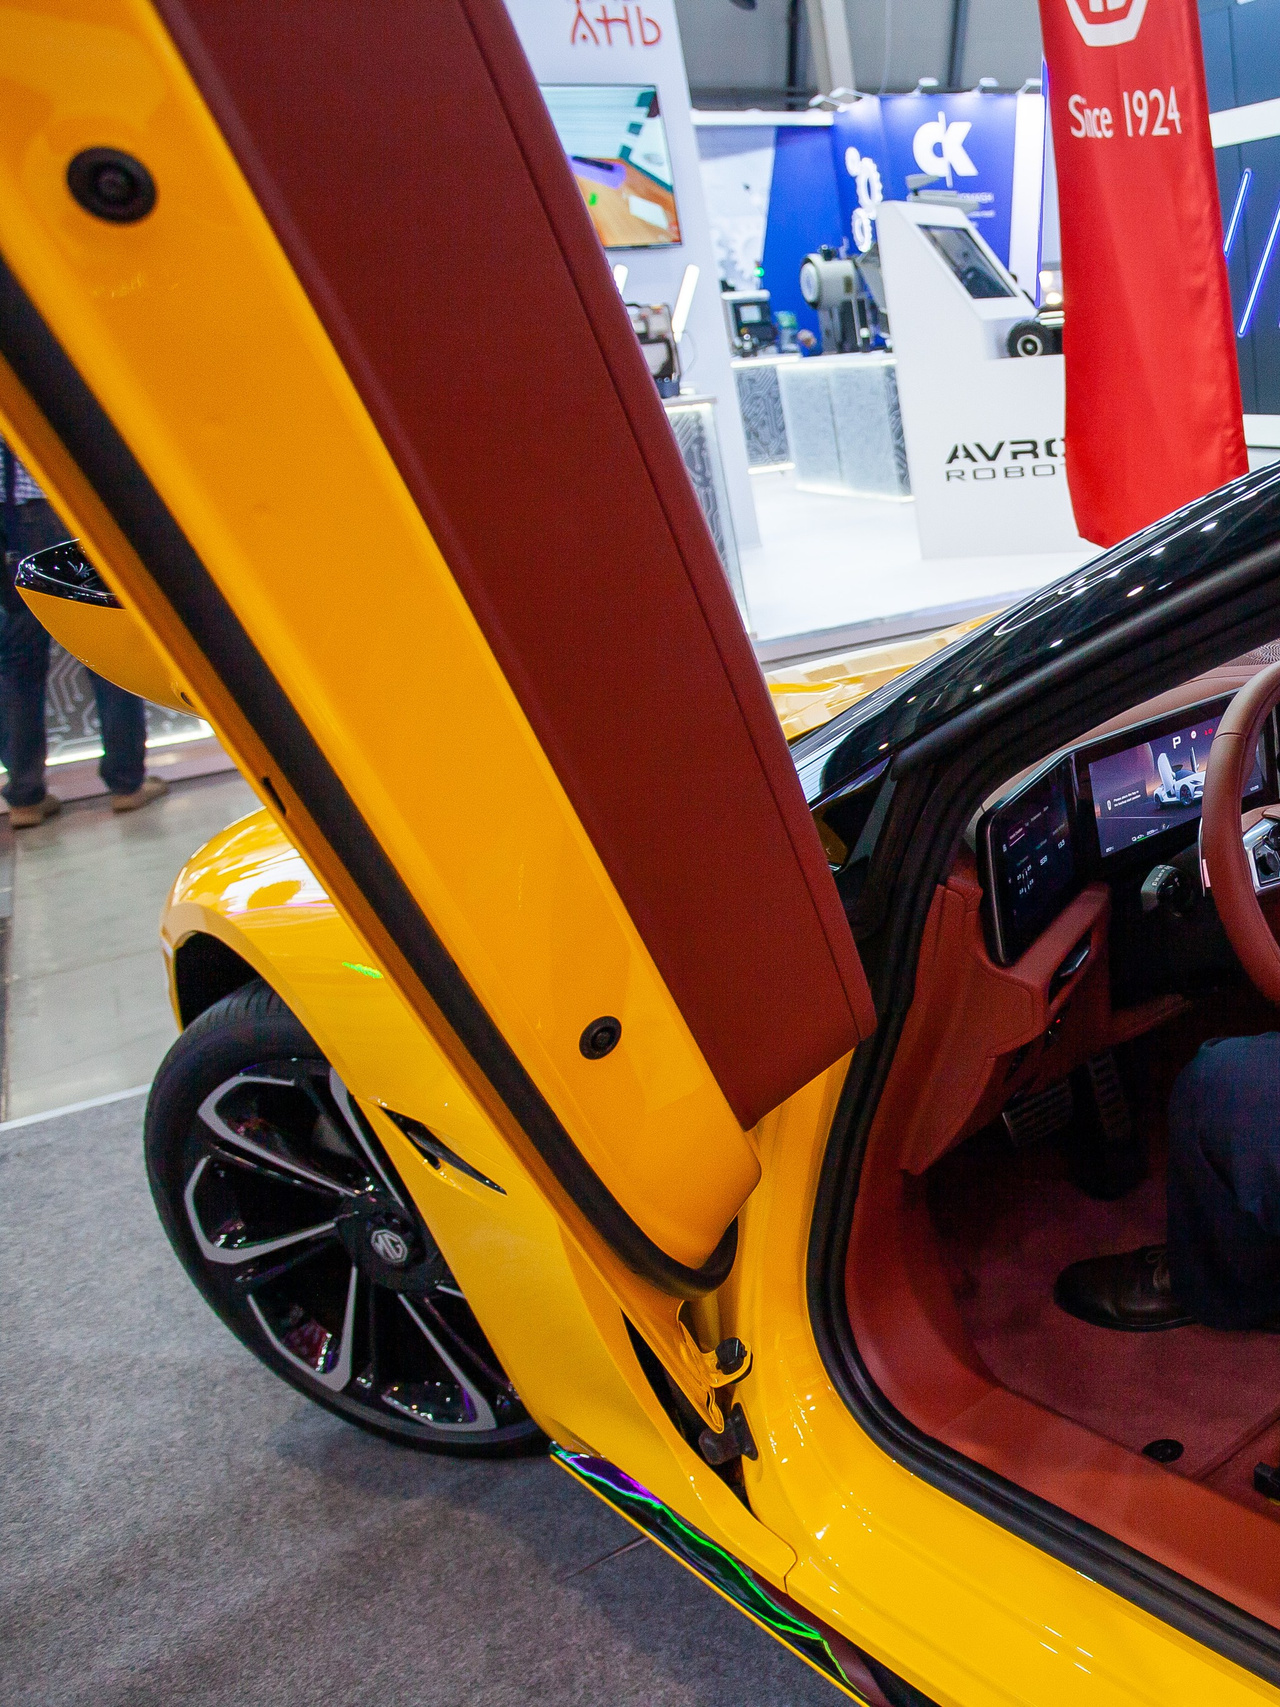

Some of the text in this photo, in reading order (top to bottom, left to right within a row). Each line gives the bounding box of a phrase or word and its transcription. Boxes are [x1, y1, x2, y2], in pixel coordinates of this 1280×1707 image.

[1122, 85, 1182, 137] 1924
[945, 463, 1065, 482] ROBO
[1172, 736, 1181, 749] P
[373, 1232, 404, 1260] MG
